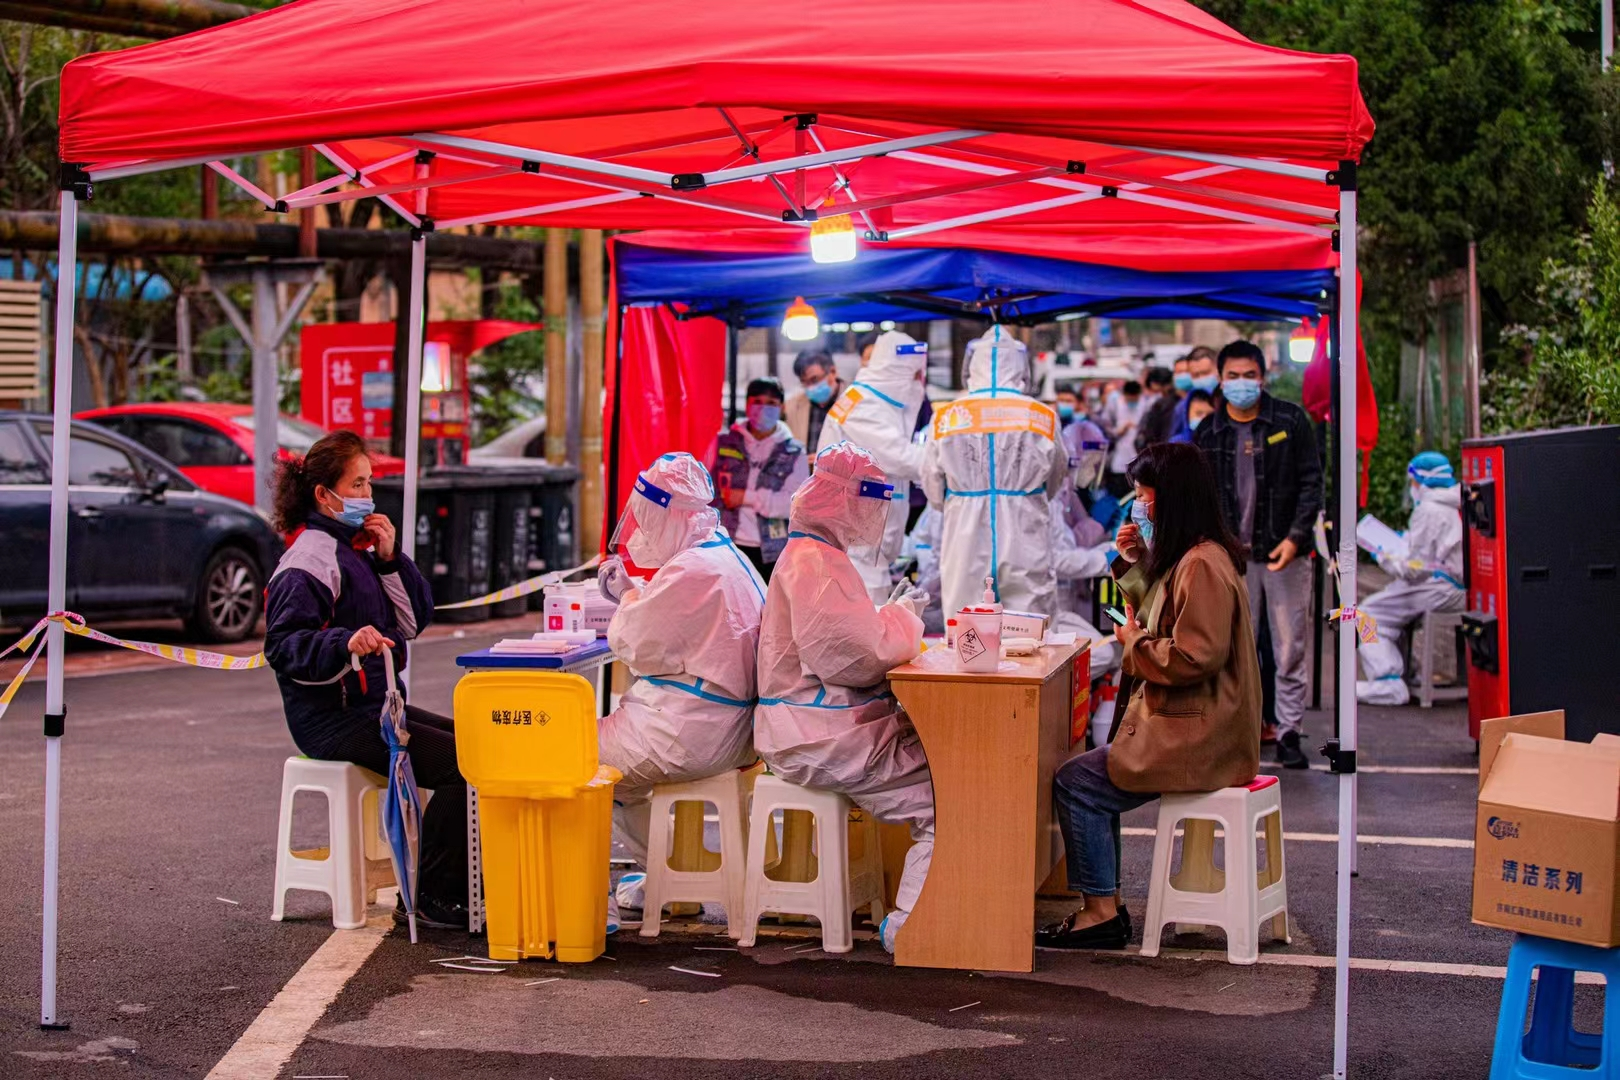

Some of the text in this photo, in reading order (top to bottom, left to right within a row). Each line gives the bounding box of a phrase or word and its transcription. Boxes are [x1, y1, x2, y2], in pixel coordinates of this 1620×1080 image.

[492, 710, 532, 726] 医疗废物
[1502, 859, 1583, 895] 清洁系列
